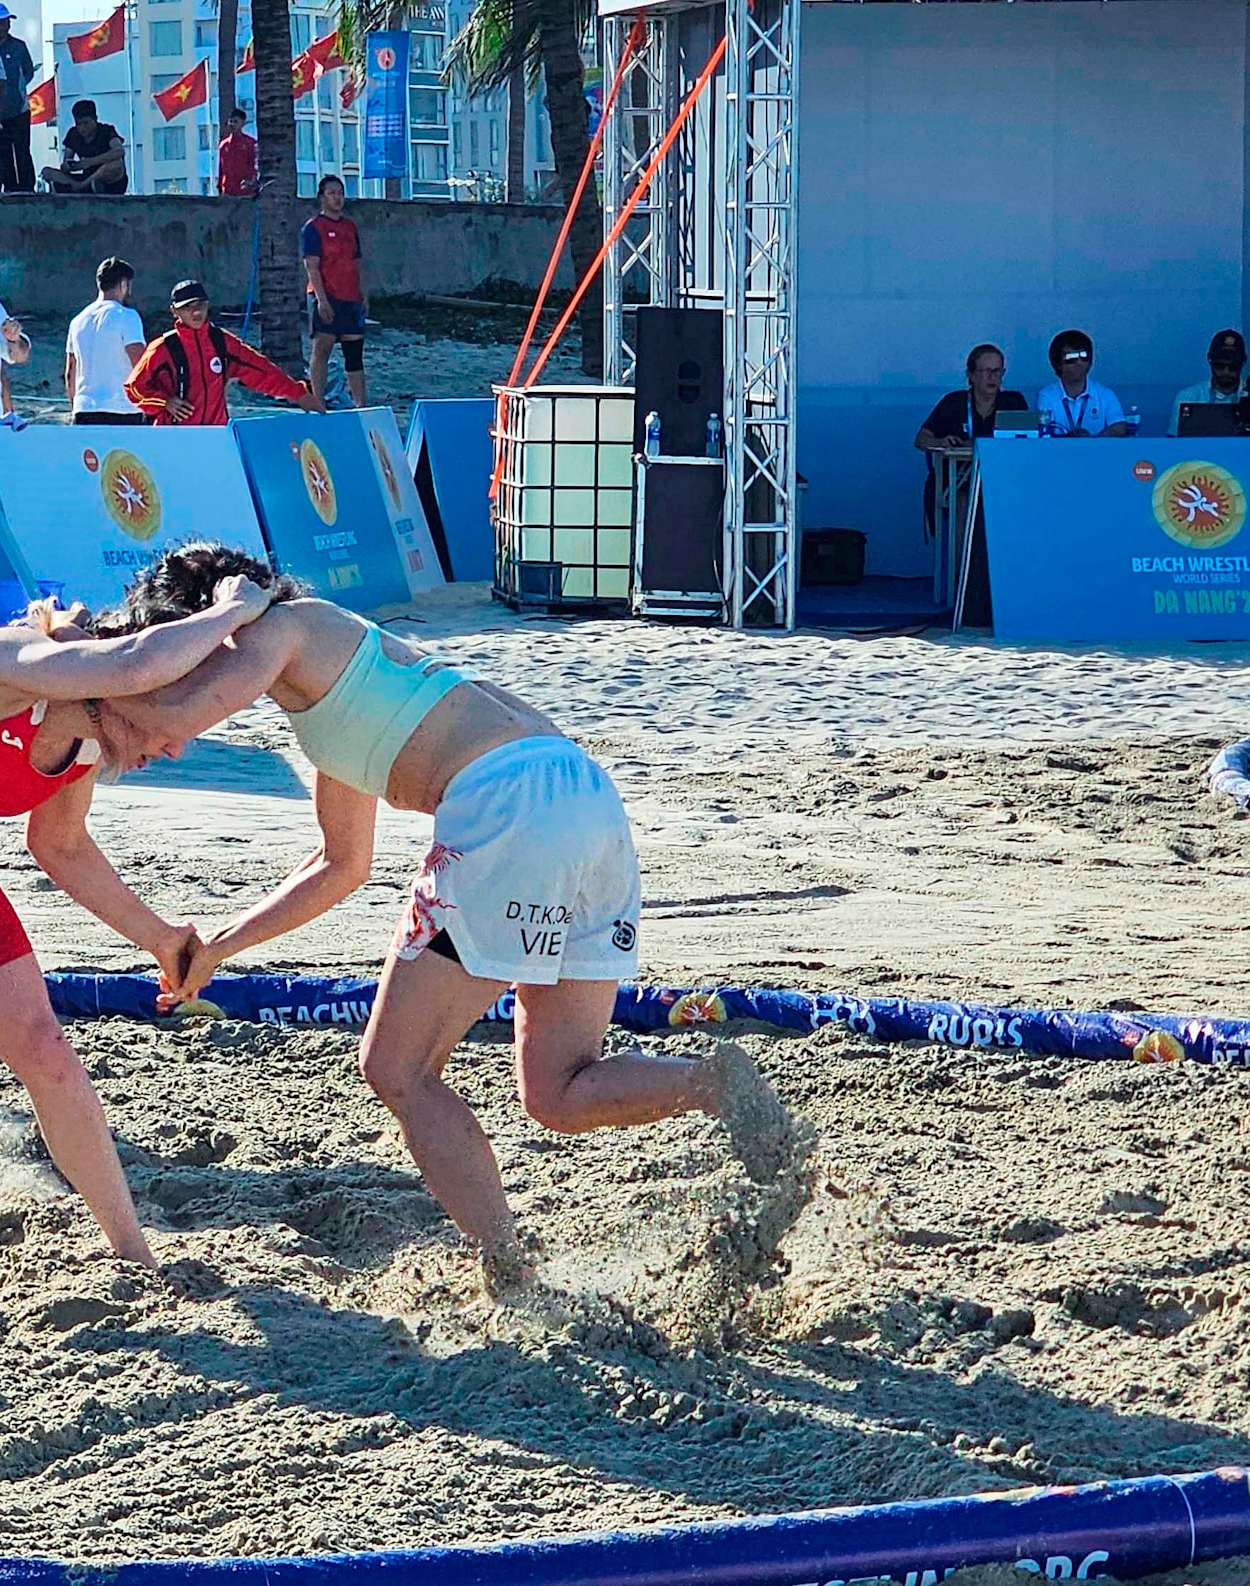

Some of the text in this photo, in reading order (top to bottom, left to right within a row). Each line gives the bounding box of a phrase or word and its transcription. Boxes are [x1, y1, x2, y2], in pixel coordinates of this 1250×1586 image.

[103, 550, 137, 566] BEACH
[1132, 556, 1250, 573] BEACH WRESTL
[1173, 572, 1240, 584] WORLD SERIES
[1154, 590, 1250, 614] DA NANG'2
[521, 928, 562, 956] VIE
[928, 1013, 1023, 1046] RUDIS
